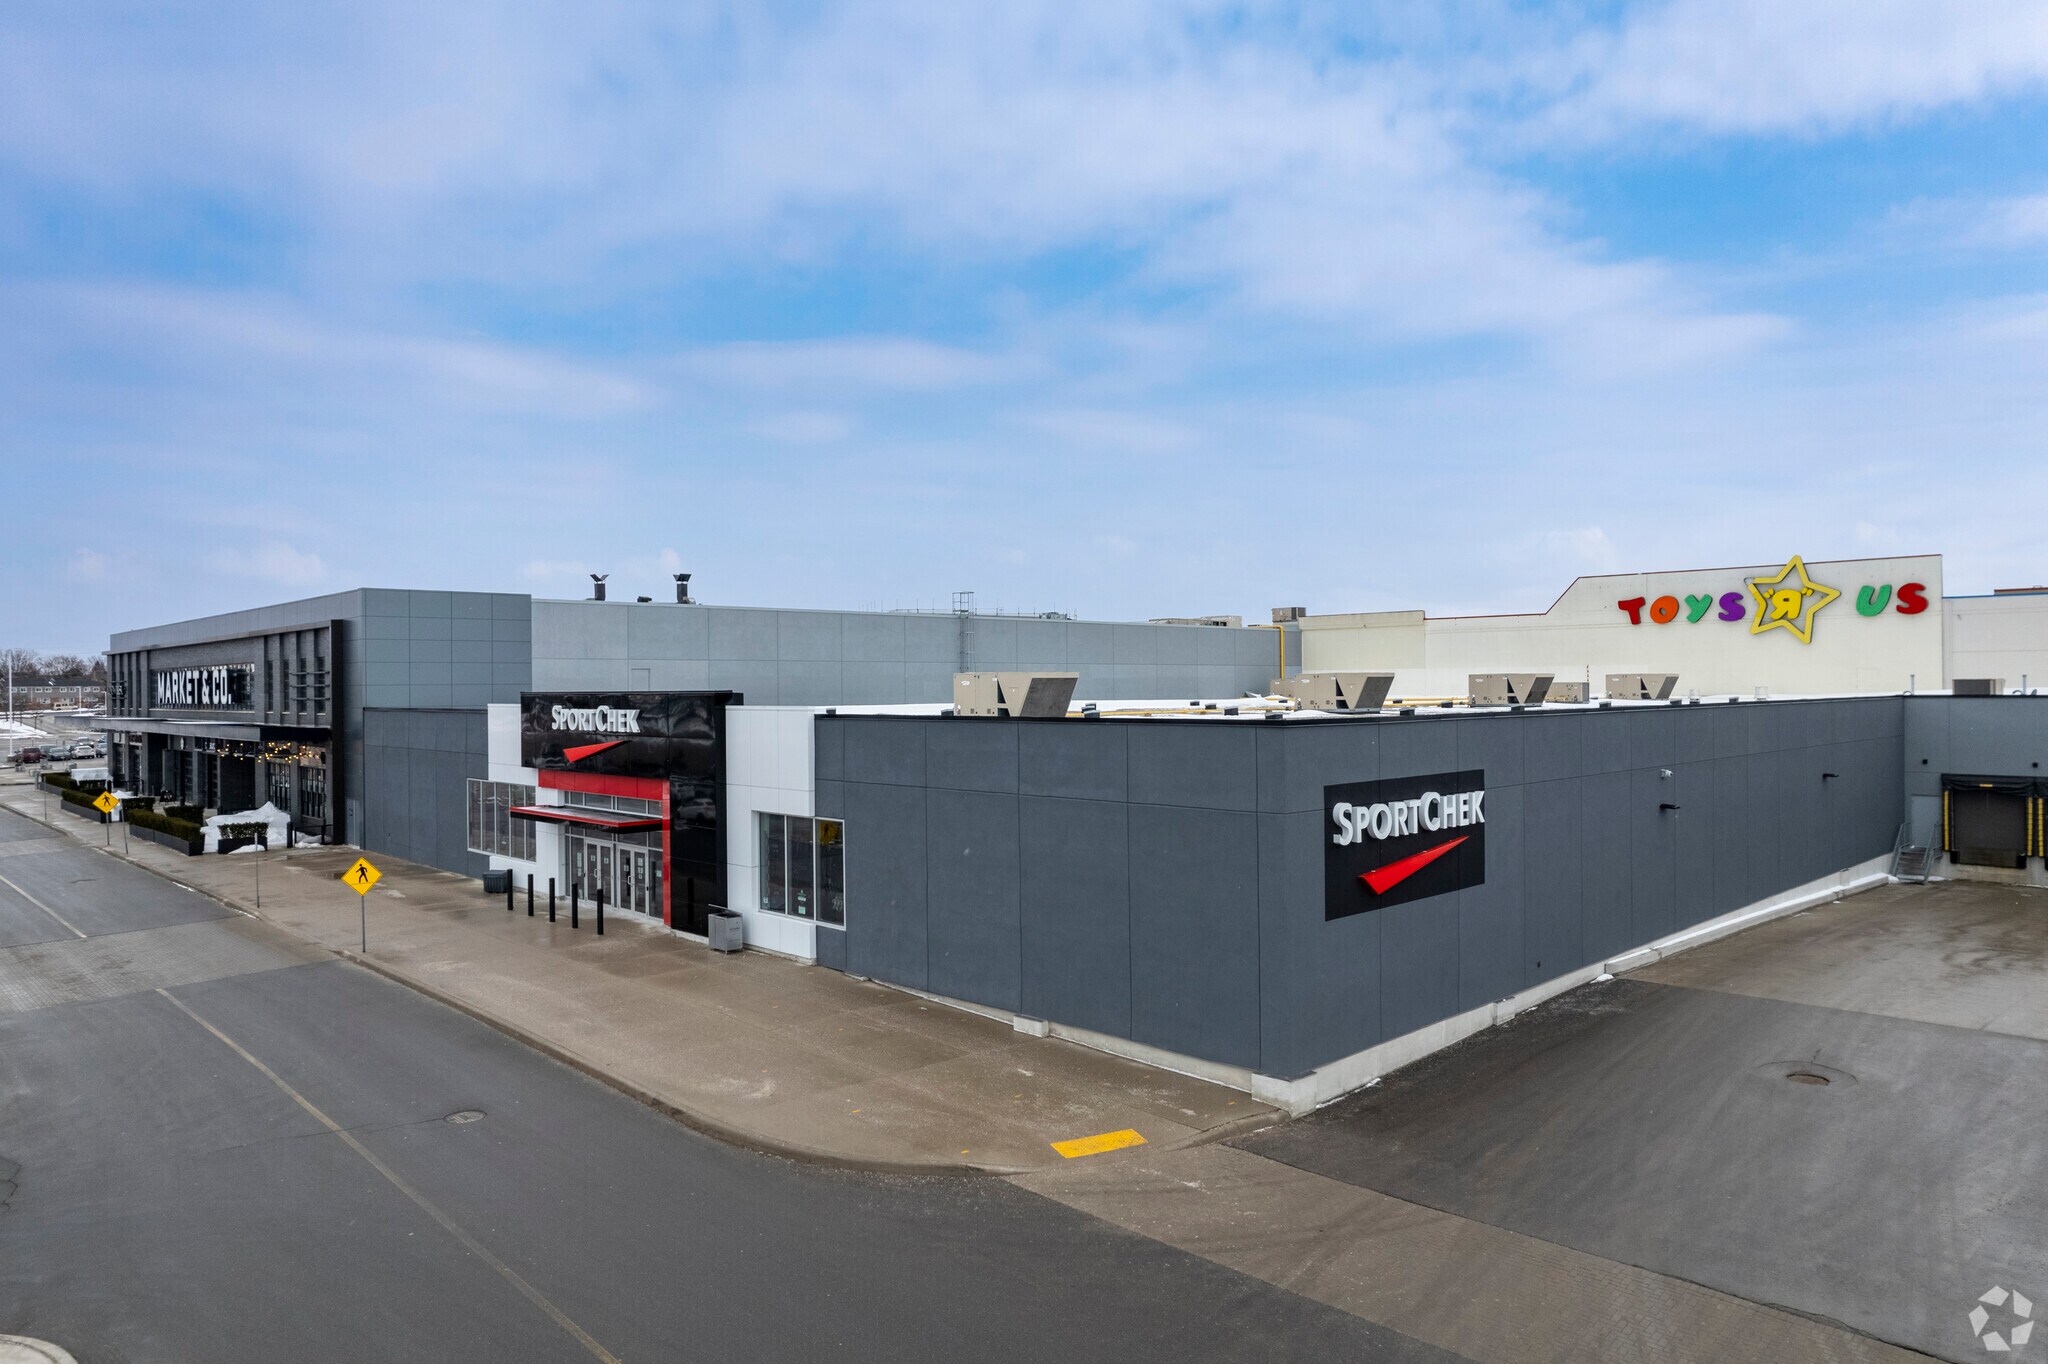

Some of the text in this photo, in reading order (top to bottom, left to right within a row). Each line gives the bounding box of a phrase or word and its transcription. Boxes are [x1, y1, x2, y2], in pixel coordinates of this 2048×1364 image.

[1618, 592, 1746, 625] TOYS
[1856, 582, 1929, 617] US
[157, 669, 232, 704] MARKET & CO.
[551, 705, 641, 733] SPORTCHEK
[1332, 790, 1486, 846] SPORTCHEK
